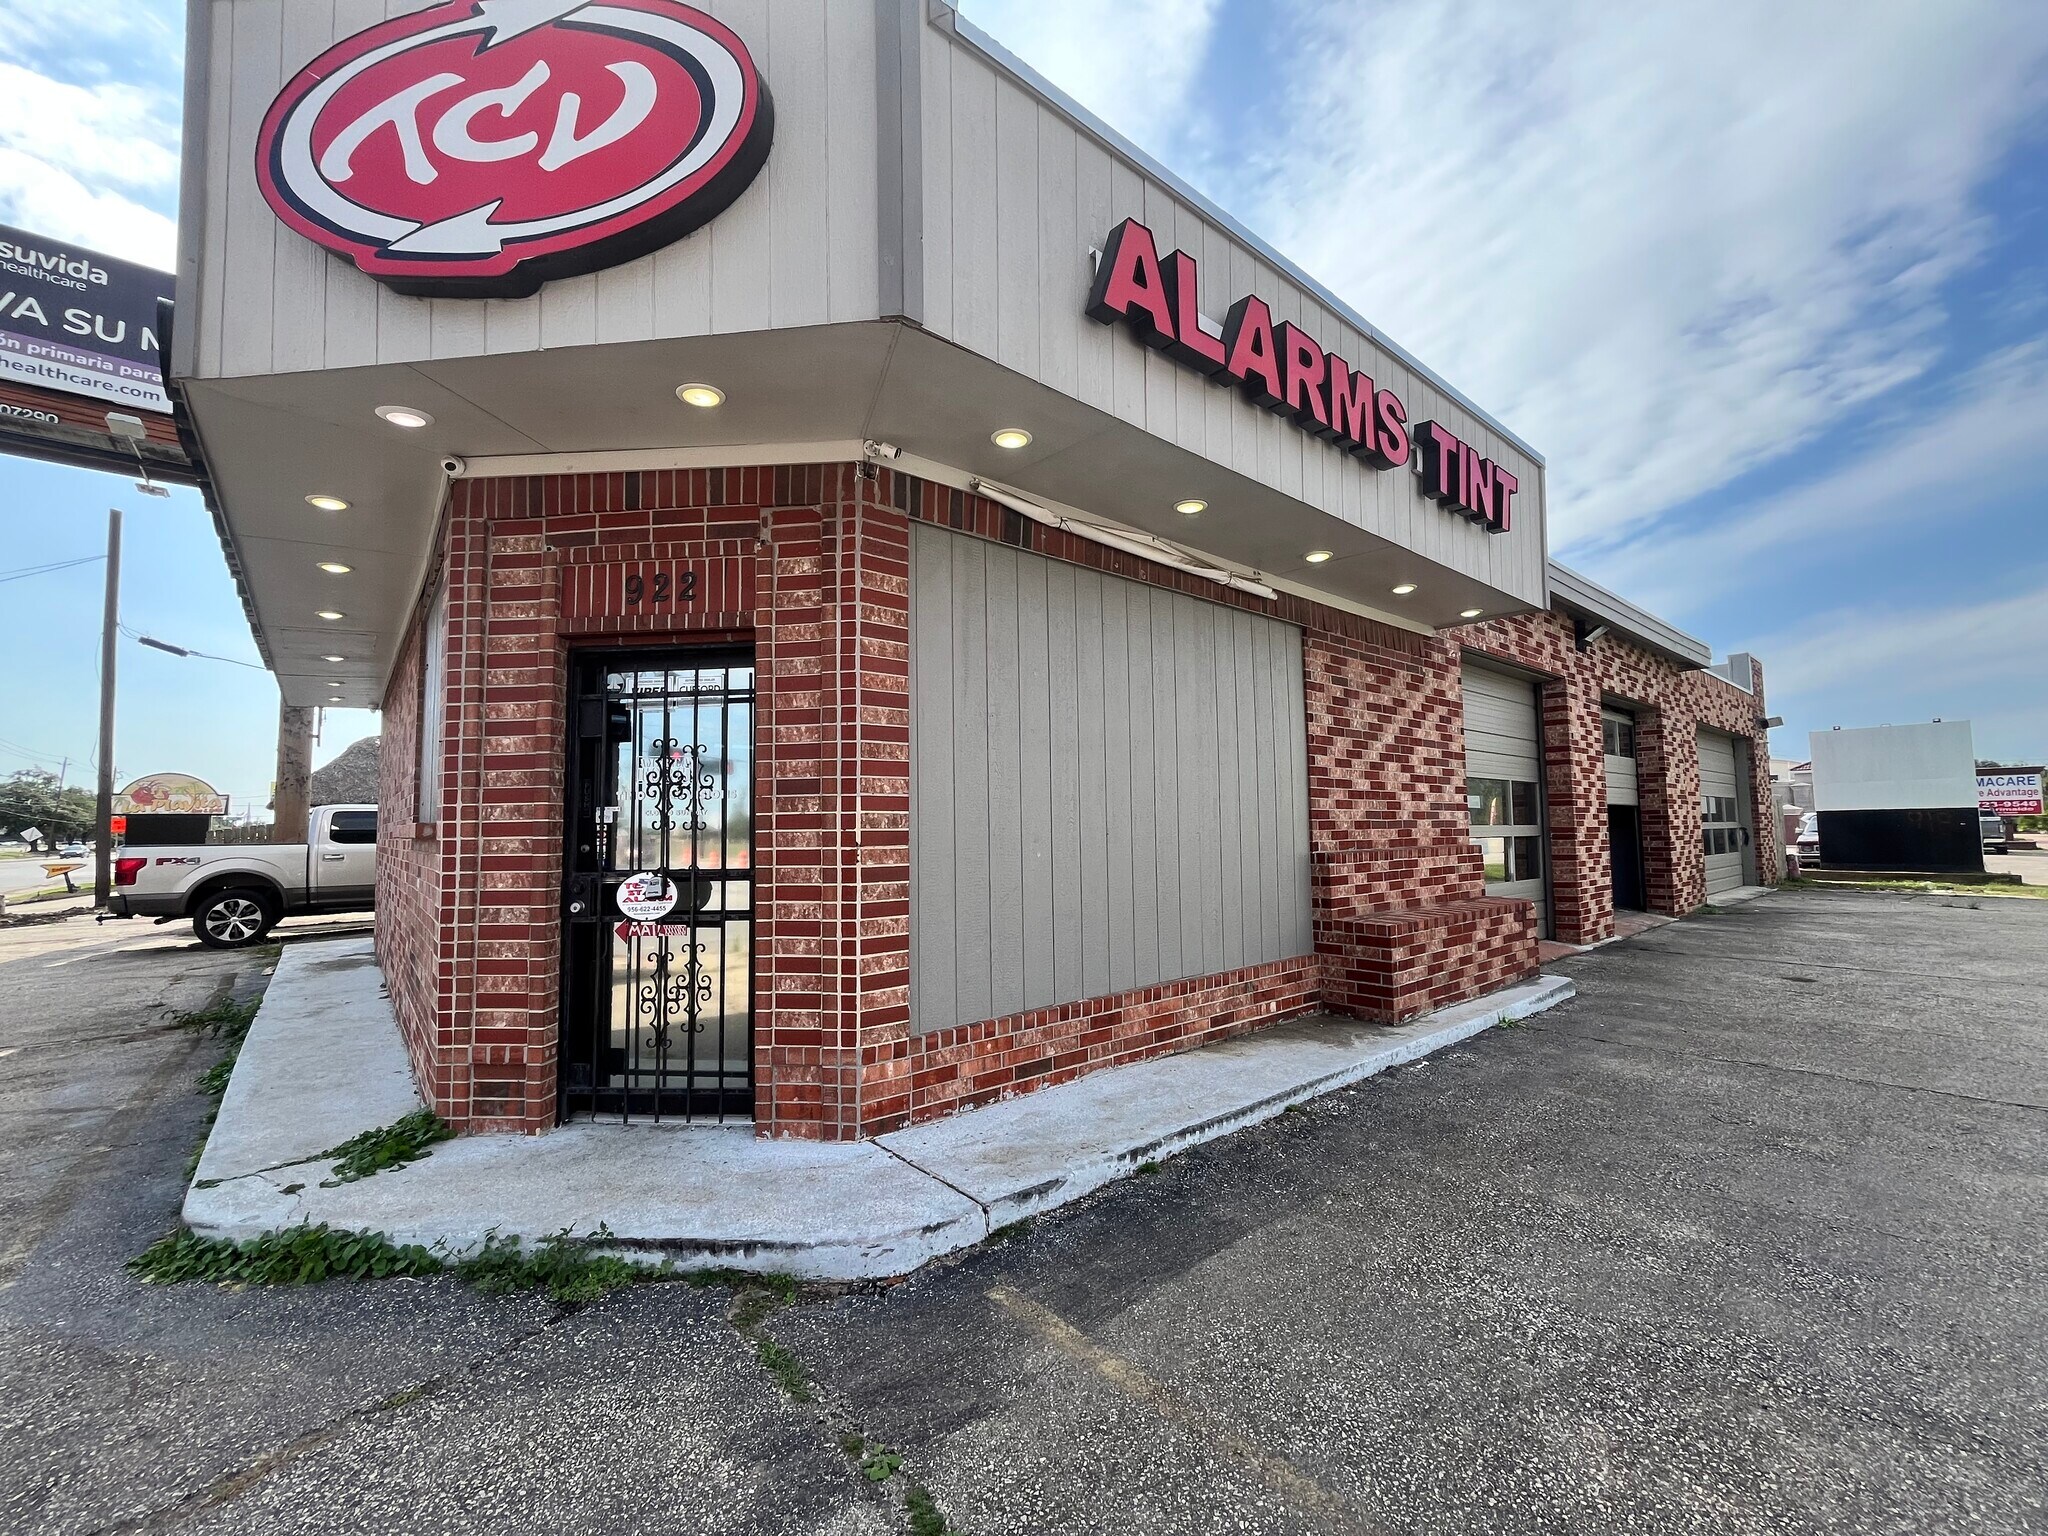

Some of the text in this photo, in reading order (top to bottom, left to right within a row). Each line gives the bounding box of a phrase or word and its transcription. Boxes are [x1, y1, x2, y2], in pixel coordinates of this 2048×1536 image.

[0, 241, 108, 285] suvida
[62, 308, 126, 343] SU
[27, 343, 114, 371] primaria
[119, 365, 162, 383] para
[1090, 217, 1518, 533] ALARMS TINT
[625, 571, 697, 605] 922
[1976, 776, 2036, 787] MACARE
[1987, 788, 2039, 798] Advantage
[1978, 800, 2038, 808] 23-9546
[156, 857, 200, 866] FX4
[622, 895, 673, 903] ALM
[628, 924, 662, 936] MAIL
